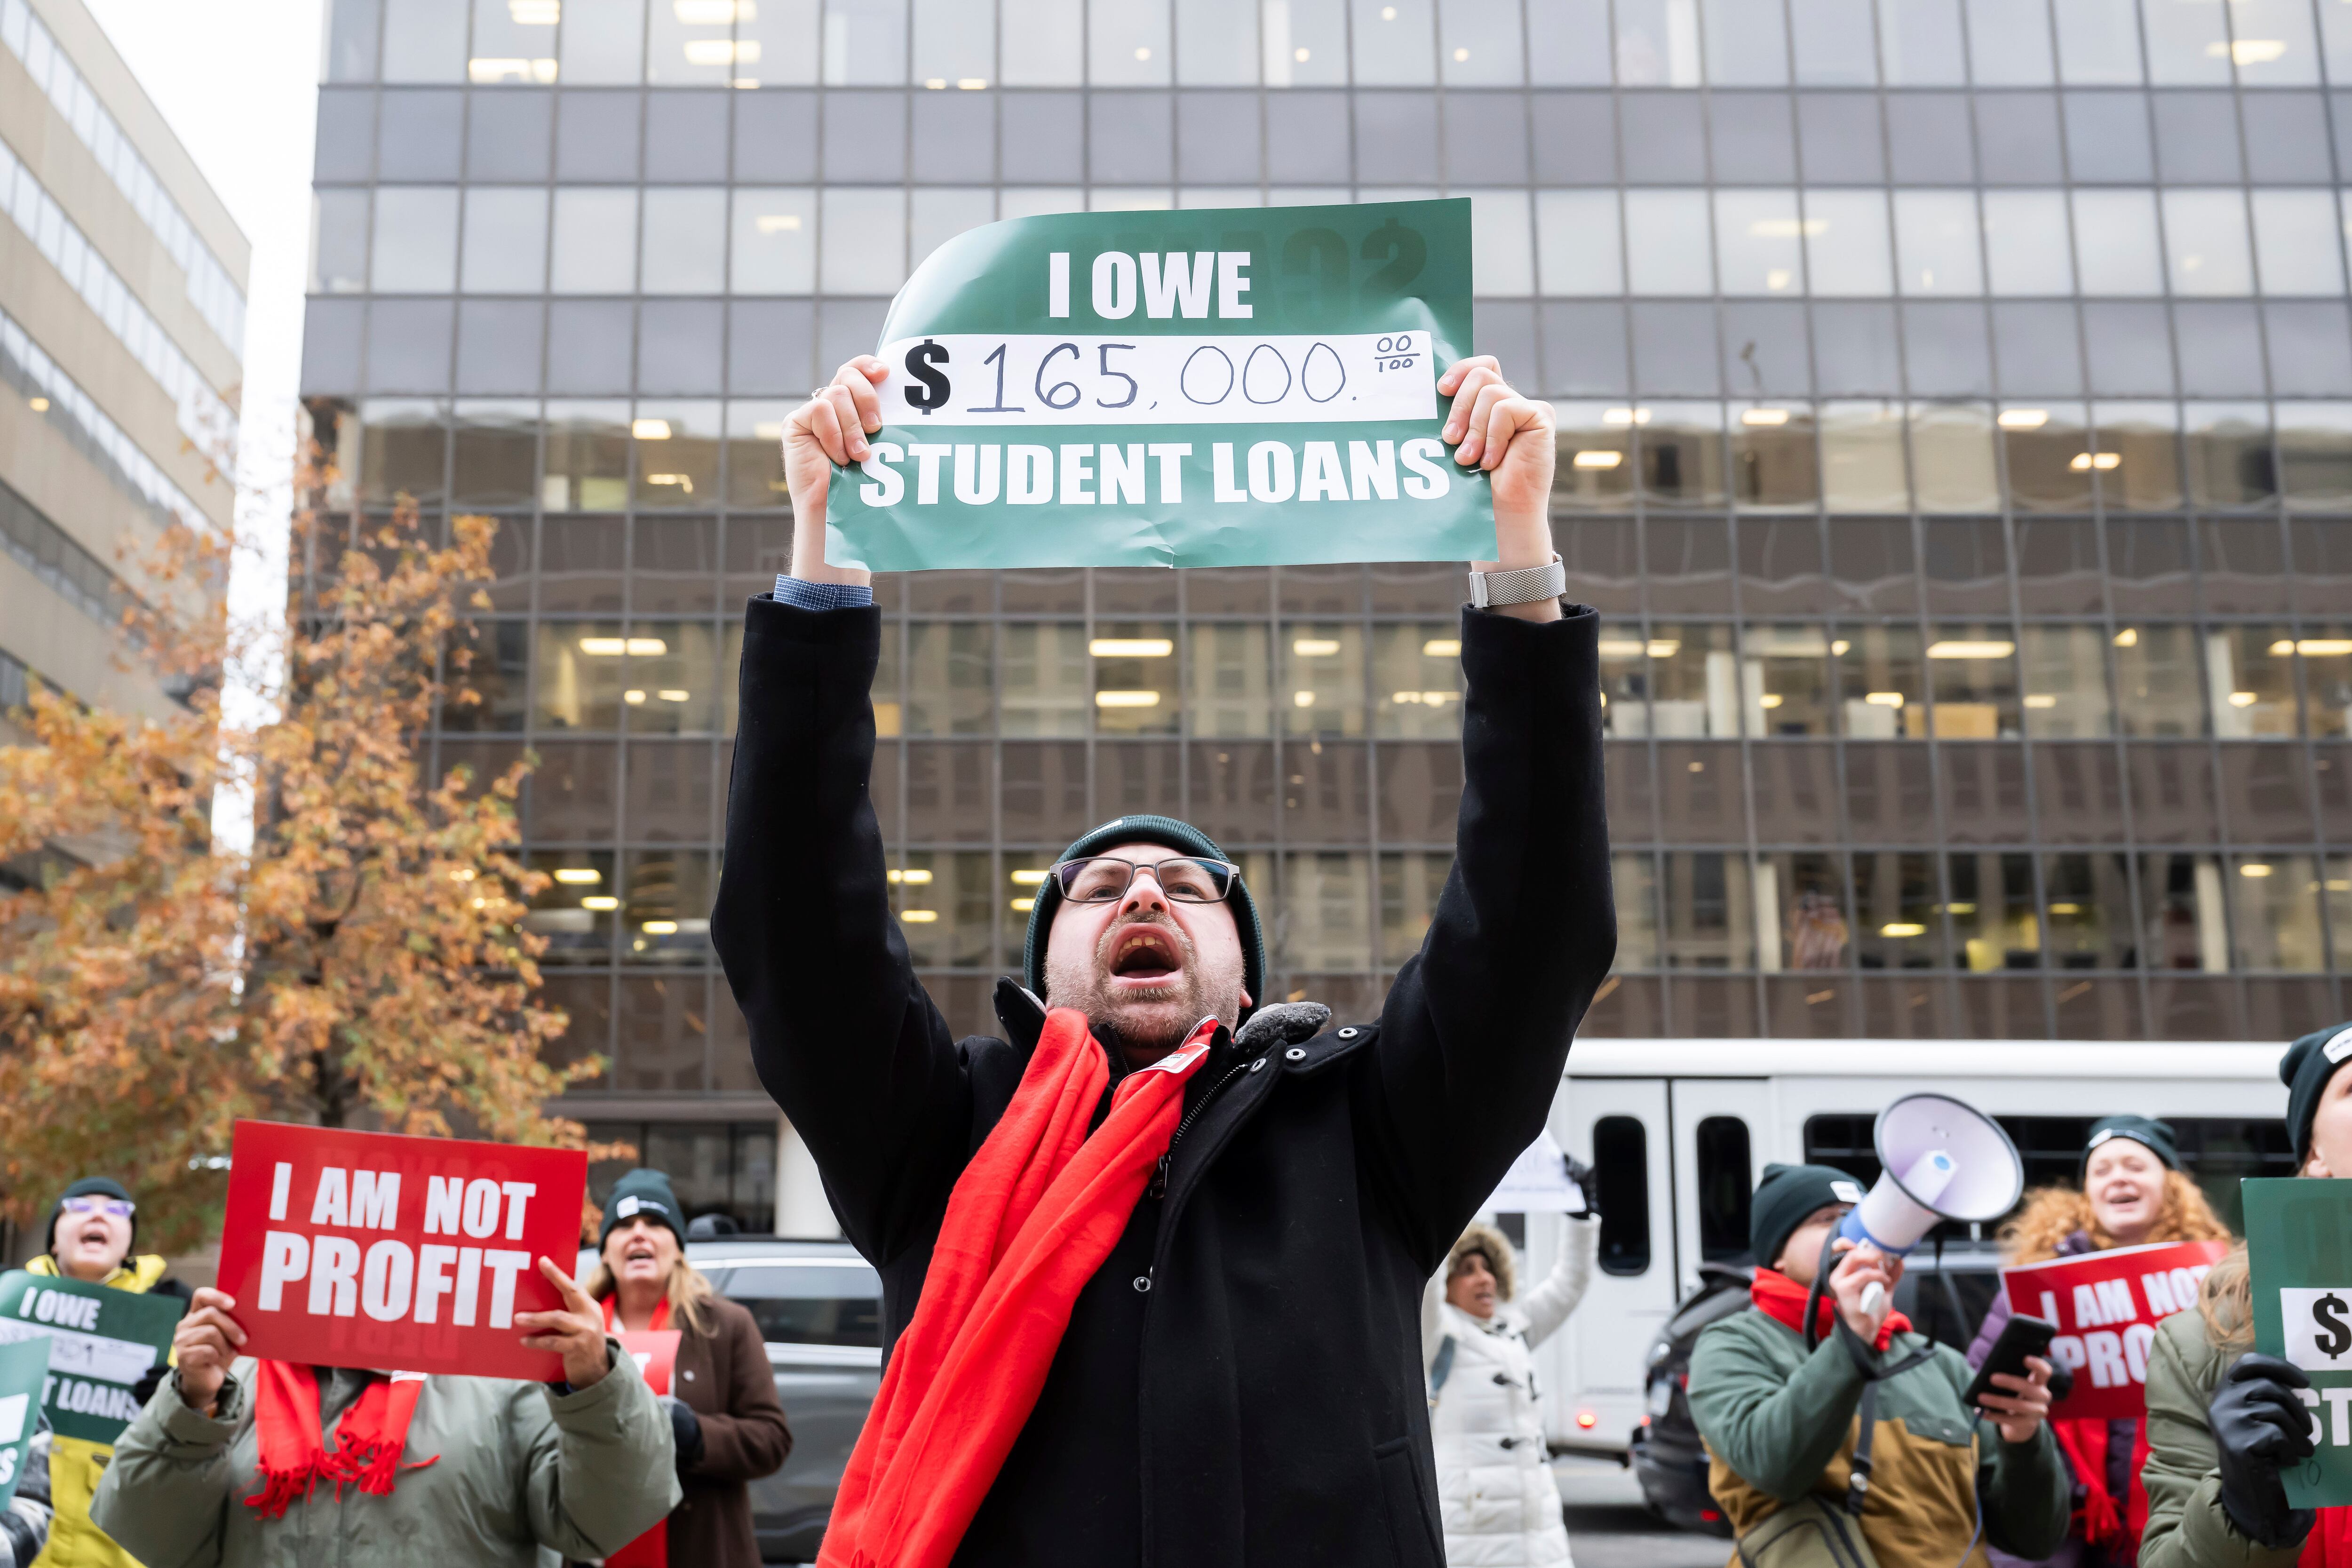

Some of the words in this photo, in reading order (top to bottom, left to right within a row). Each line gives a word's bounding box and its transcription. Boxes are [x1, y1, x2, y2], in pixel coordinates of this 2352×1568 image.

[1049, 252, 1070, 318] I
[1092, 251, 1253, 319] OWE
[904, 339, 951, 415] $
[860, 442, 1192, 507] STUDENT
[1213, 439, 1450, 502] LOANS
[269, 1162, 292, 1221] I
[310, 1166, 401, 1231] AM
[424, 1176, 536, 1240] NOT
[19, 1287, 38, 1317] I
[35, 1289, 102, 1330] OWE
[258, 1230, 531, 1329] PROFIT
[2073, 1278, 2137, 1329] AM
[2312, 1293, 2352, 1360] $
